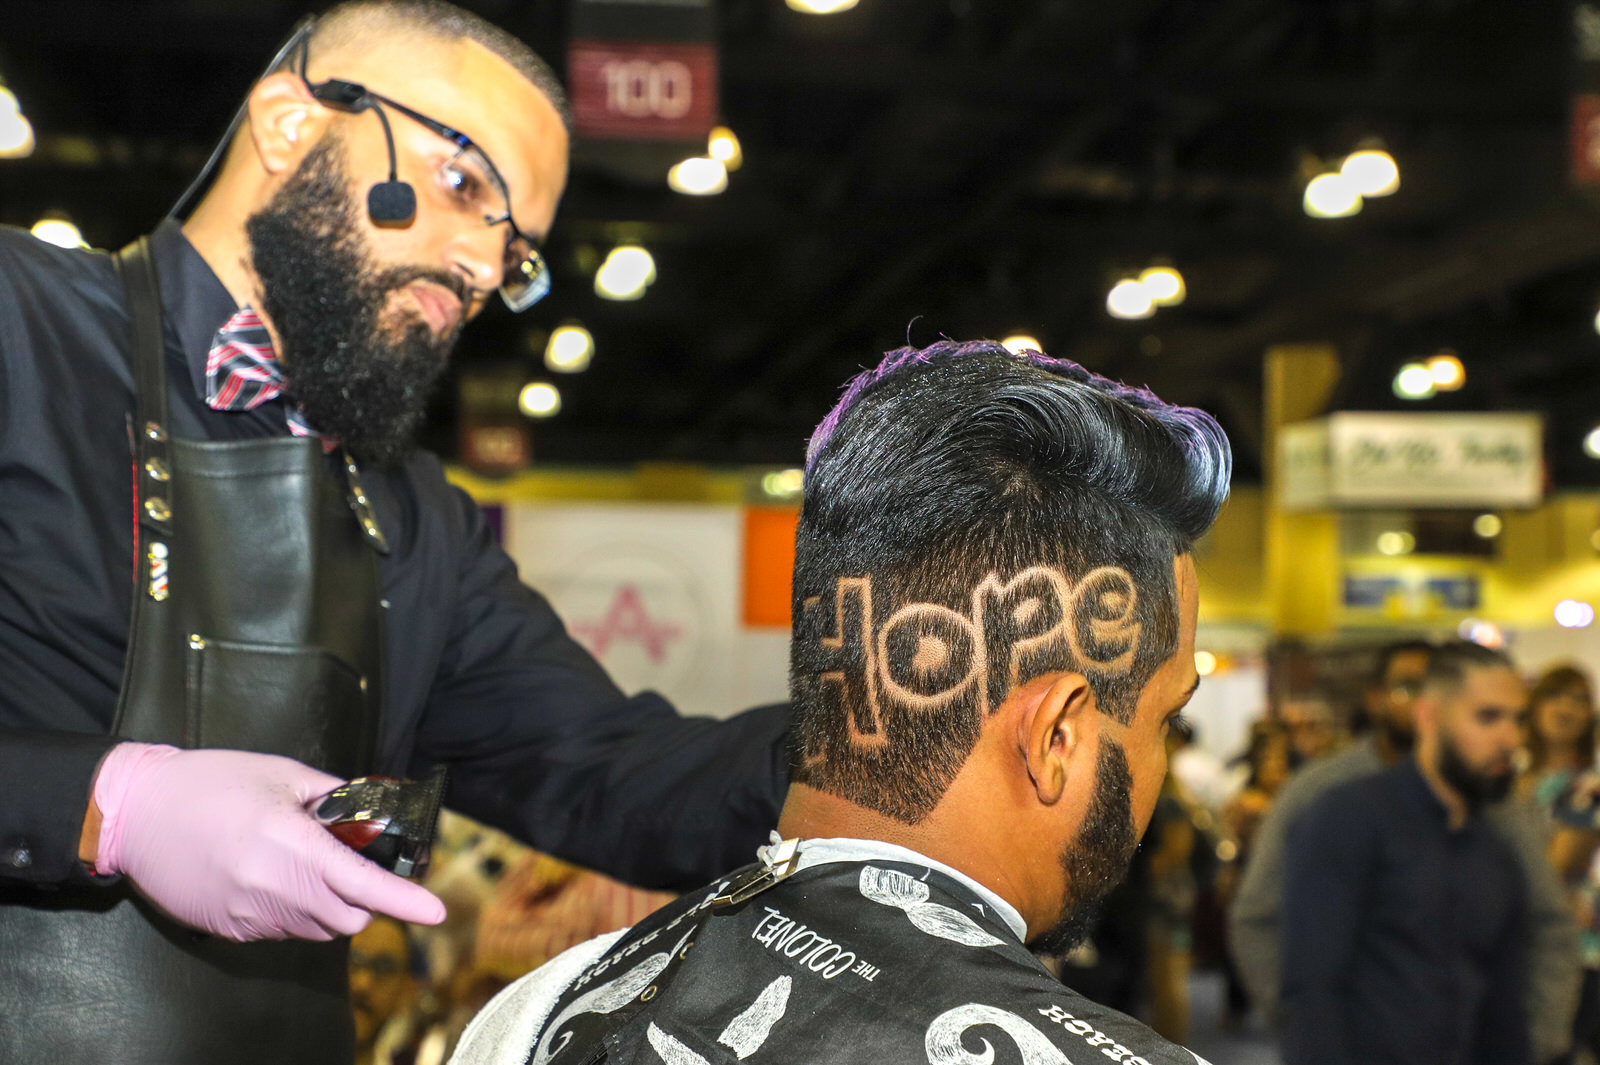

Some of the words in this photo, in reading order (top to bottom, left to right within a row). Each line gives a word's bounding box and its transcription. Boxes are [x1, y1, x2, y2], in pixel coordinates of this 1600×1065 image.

[603, 61, 692, 119] 100
[751, 906, 856, 980] COLONEL
[851, 960, 881, 982] THE
